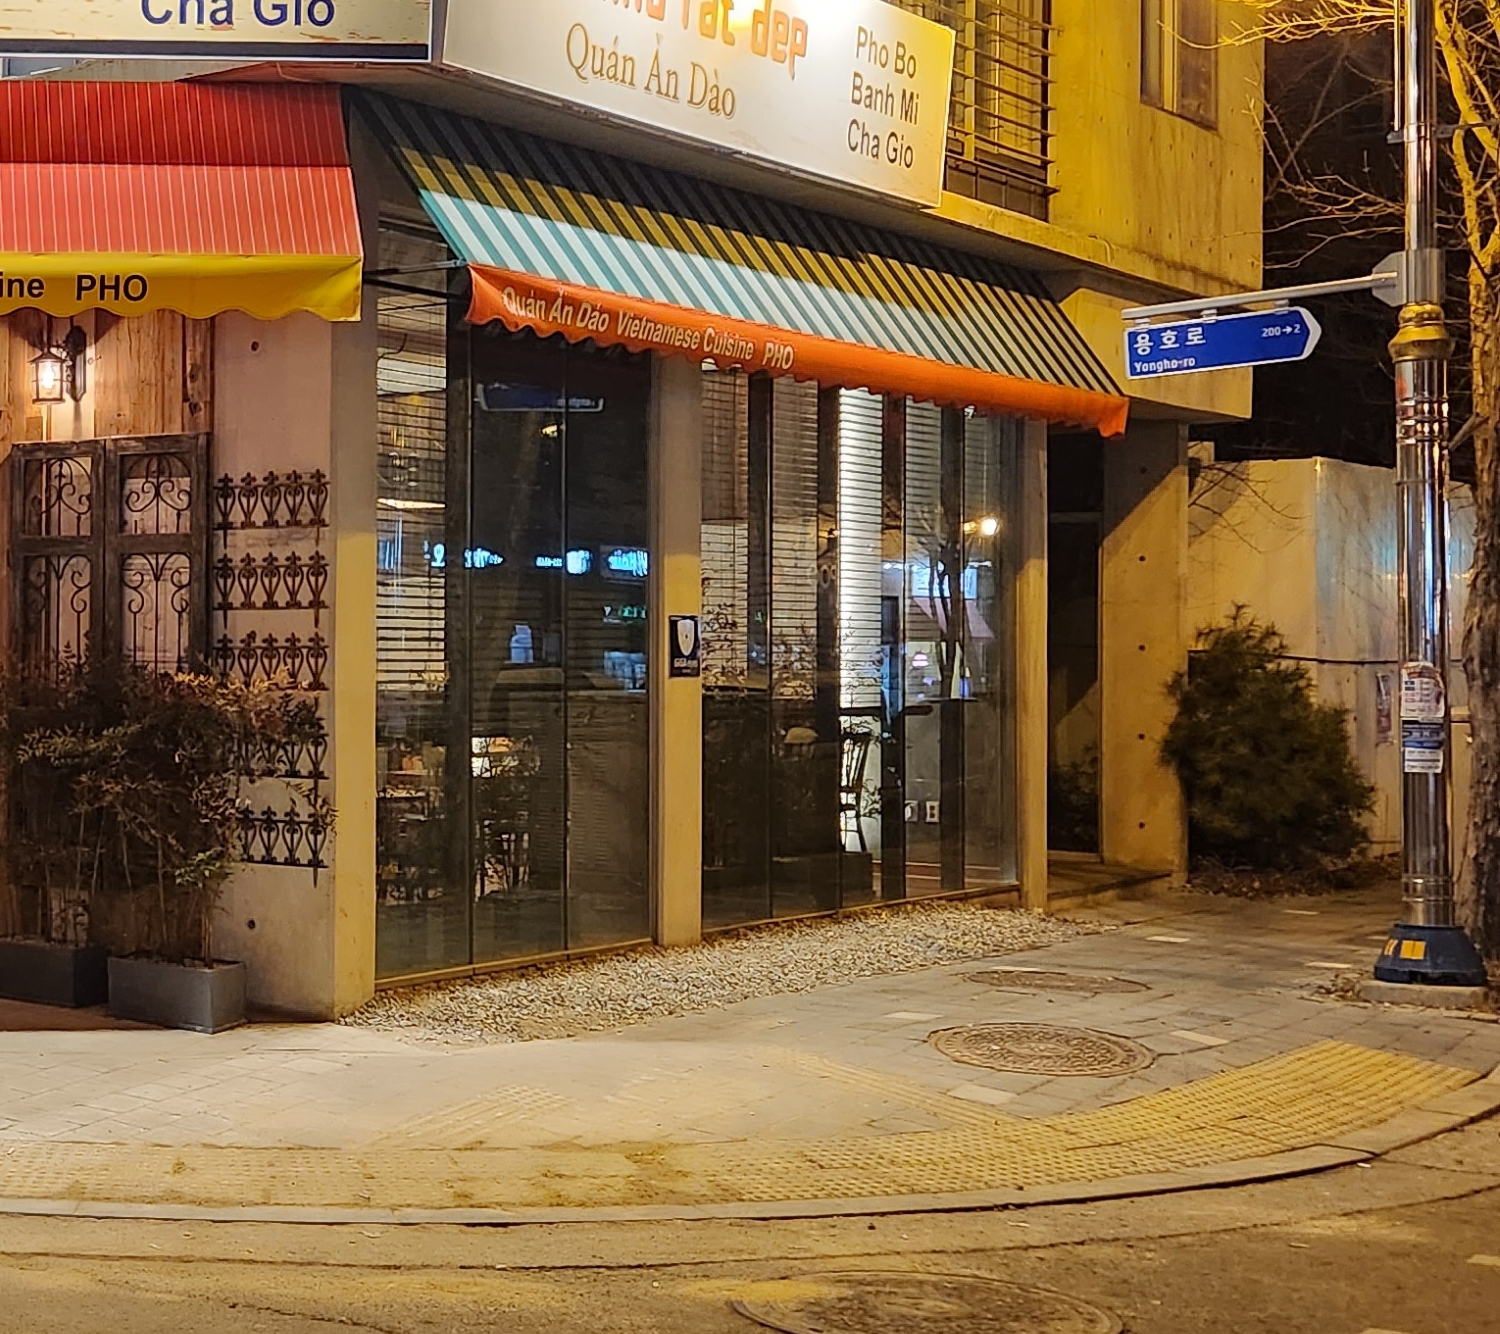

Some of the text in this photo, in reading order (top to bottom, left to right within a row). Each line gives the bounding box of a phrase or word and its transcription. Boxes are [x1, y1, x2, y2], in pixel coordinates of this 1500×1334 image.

[566, 22, 636, 84] Quán
[687, 61, 736, 119] Dào
[856, 25, 917, 79] Pho Bo
[851, 71, 919, 125] Banh Mi
[847, 119, 914, 169] Cha Gio
[75, 273, 148, 302] PHO
[616, 310, 701, 350] Vietnamese
[703, 327, 755, 360] Cuisine
[762, 342, 794, 370] PHO
[1133, 327, 1206, 355] 용호로
[1134, 357, 1196, 373] Yongho-ro
